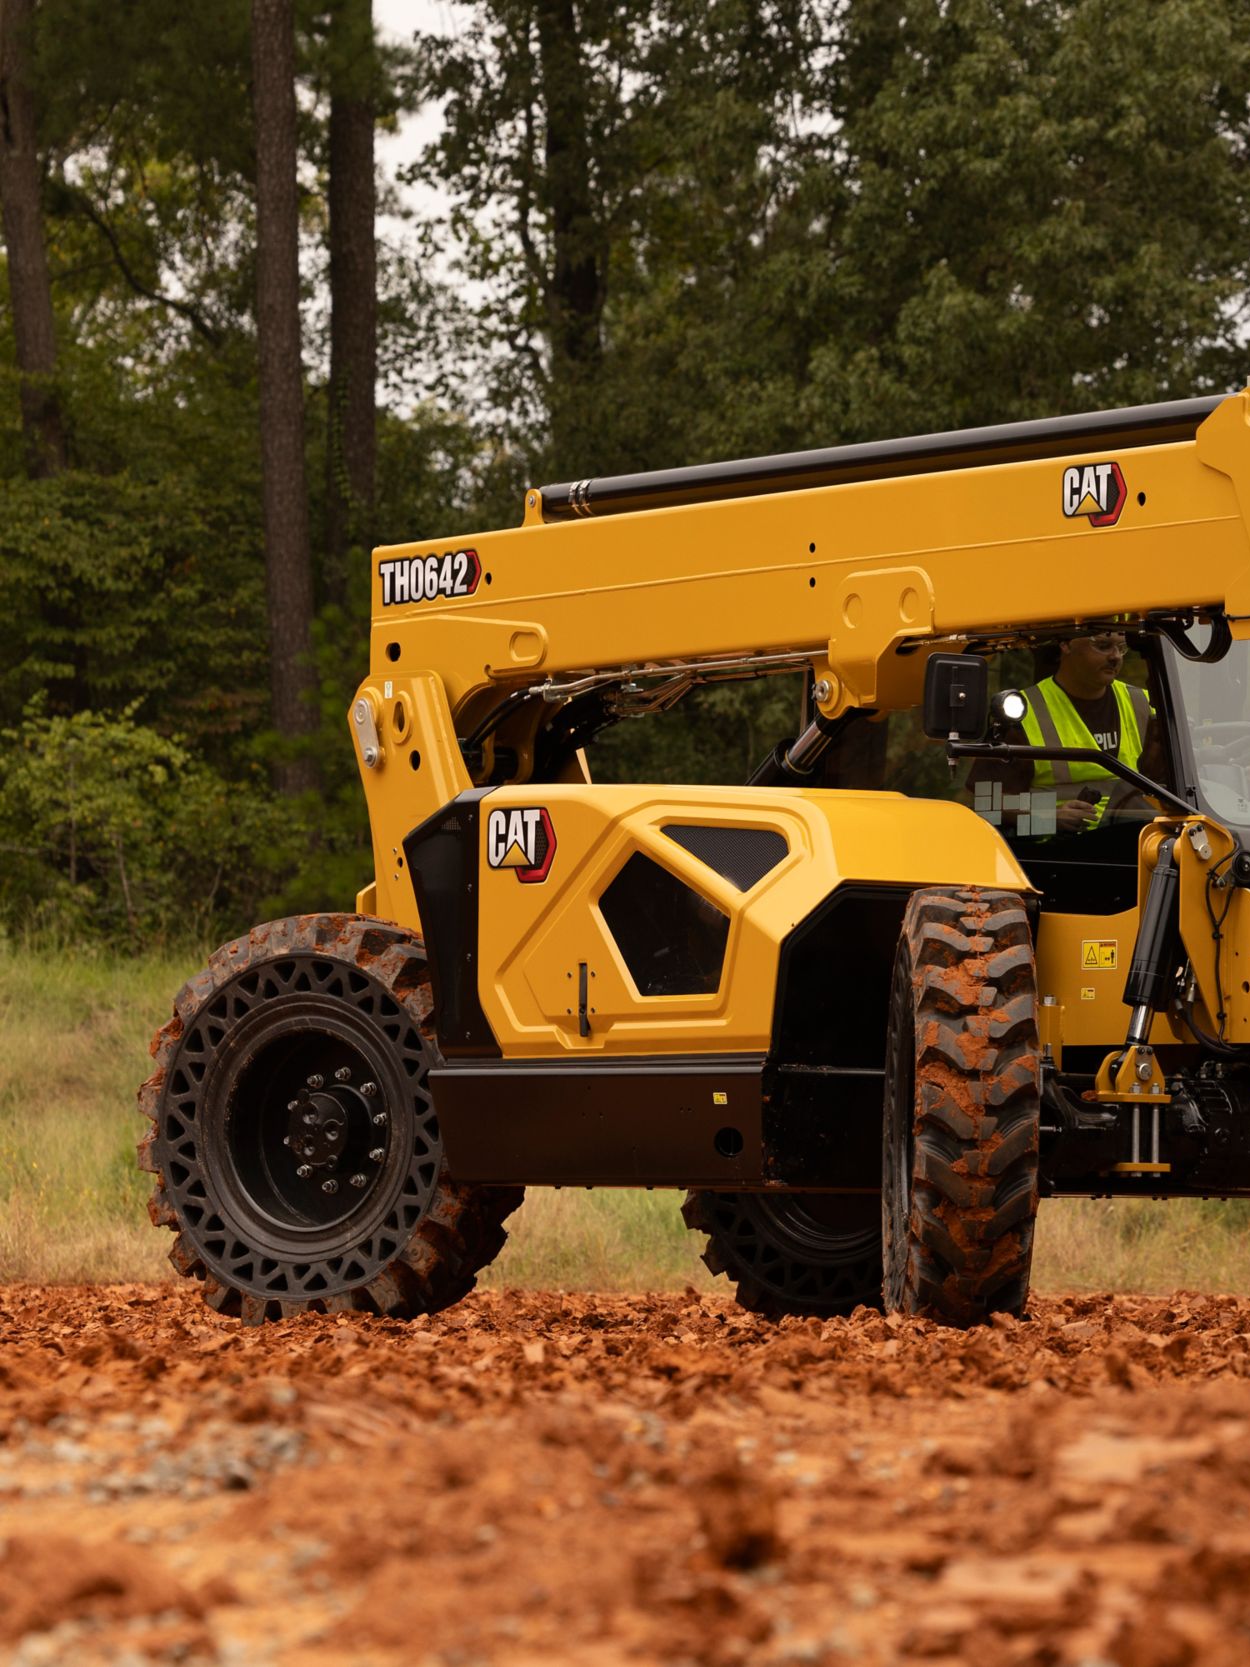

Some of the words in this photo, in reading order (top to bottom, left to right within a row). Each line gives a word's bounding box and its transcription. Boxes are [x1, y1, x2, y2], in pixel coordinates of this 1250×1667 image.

[1064, 464, 1112, 516] CAT
[380, 552, 468, 604] TH0642
[488, 809, 541, 867] CAT
